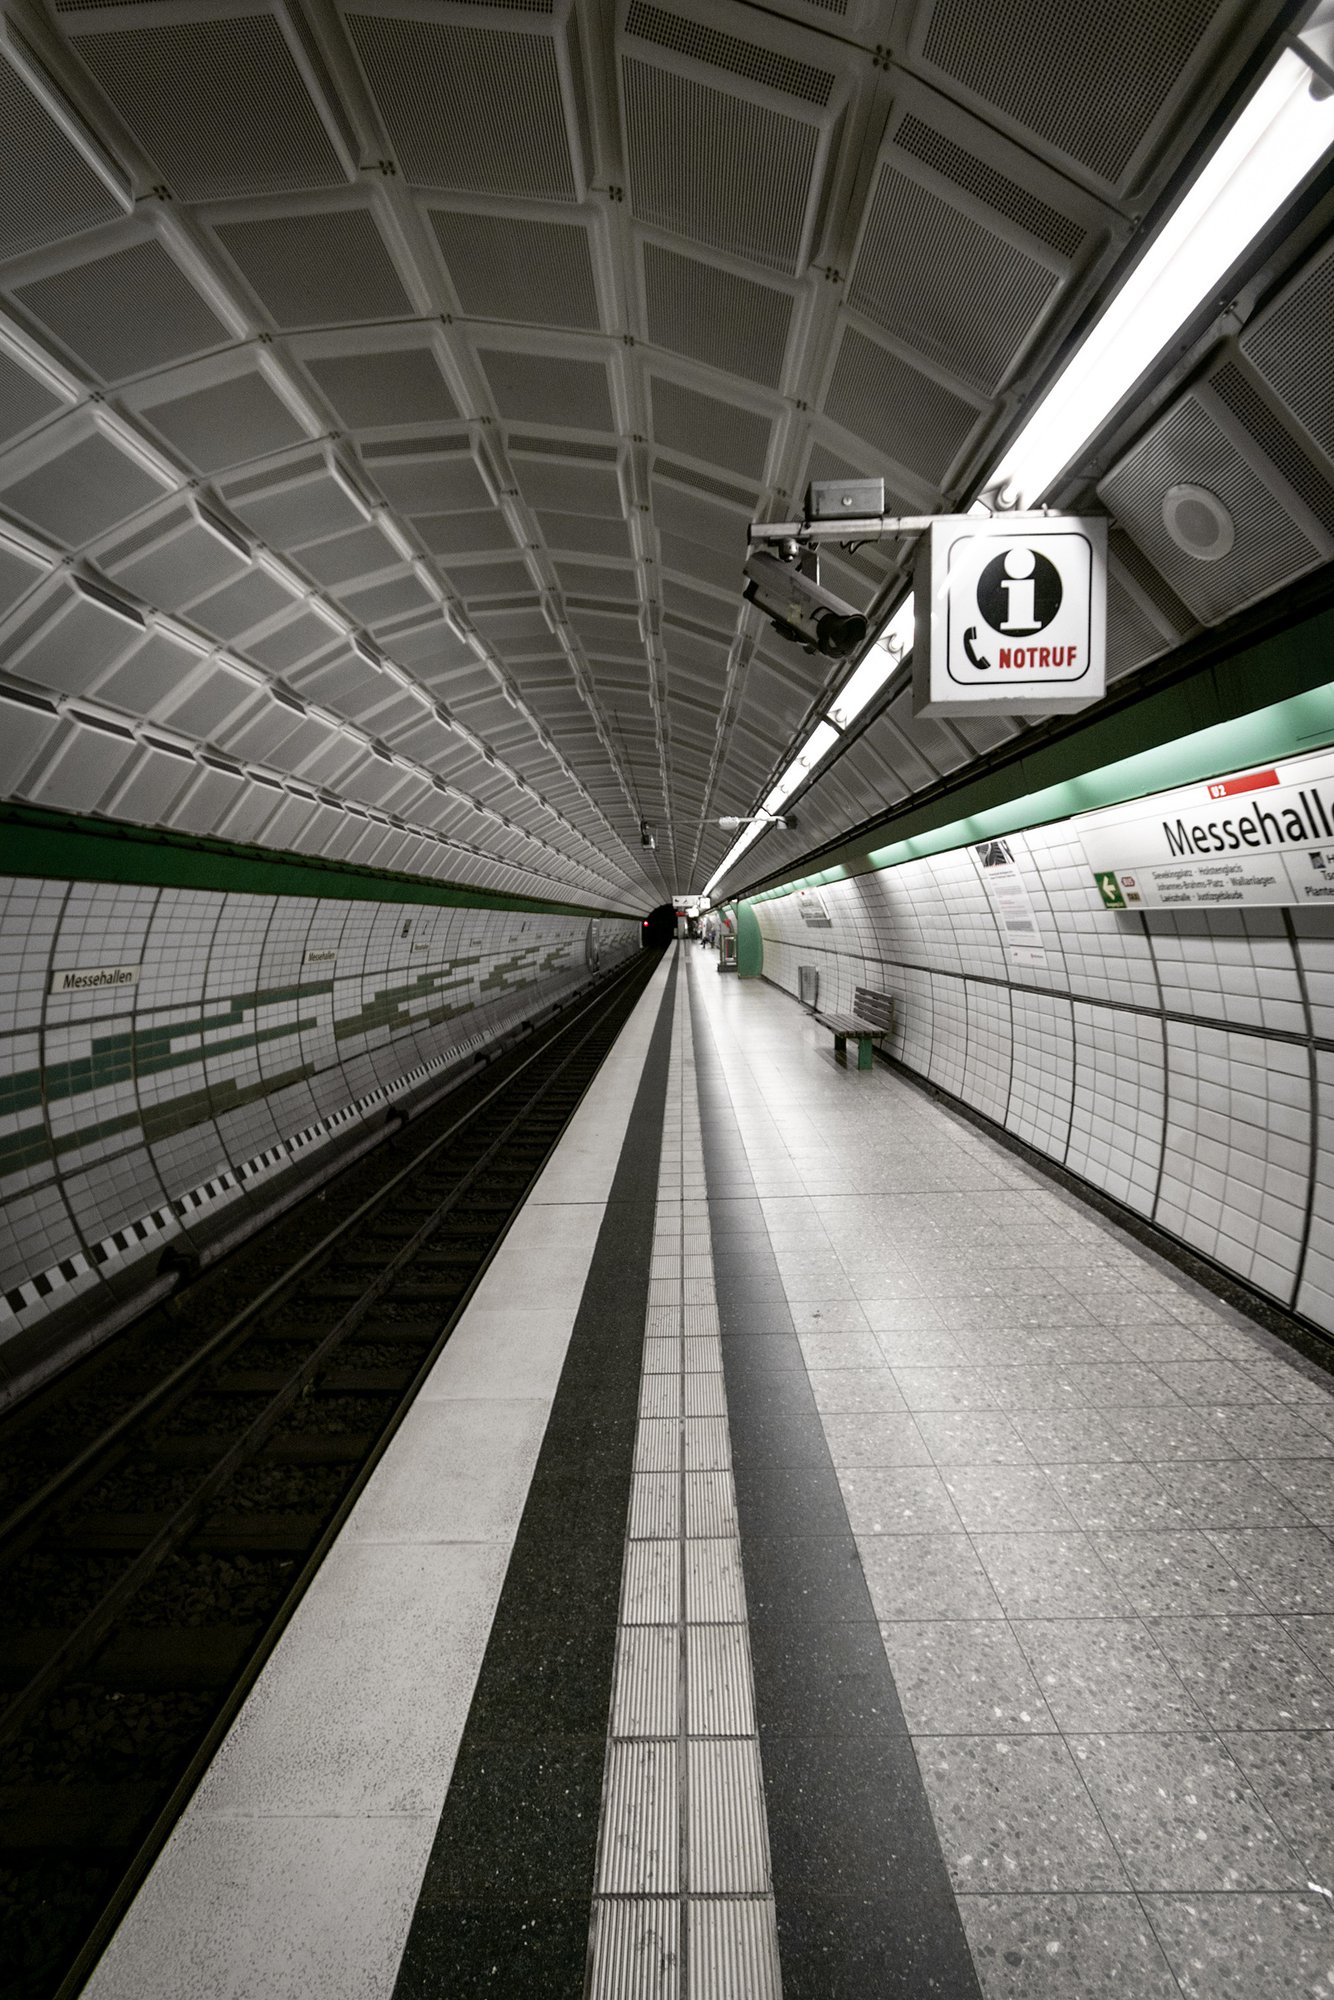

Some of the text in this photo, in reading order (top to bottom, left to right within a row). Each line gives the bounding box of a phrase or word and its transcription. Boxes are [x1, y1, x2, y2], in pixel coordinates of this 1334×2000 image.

[999, 646, 1078, 669] NOTRUF
[1210, 784, 1227, 798] U2
[1162, 788, 1334, 857] Messehall
[62, 969, 133, 990] Messehallen
